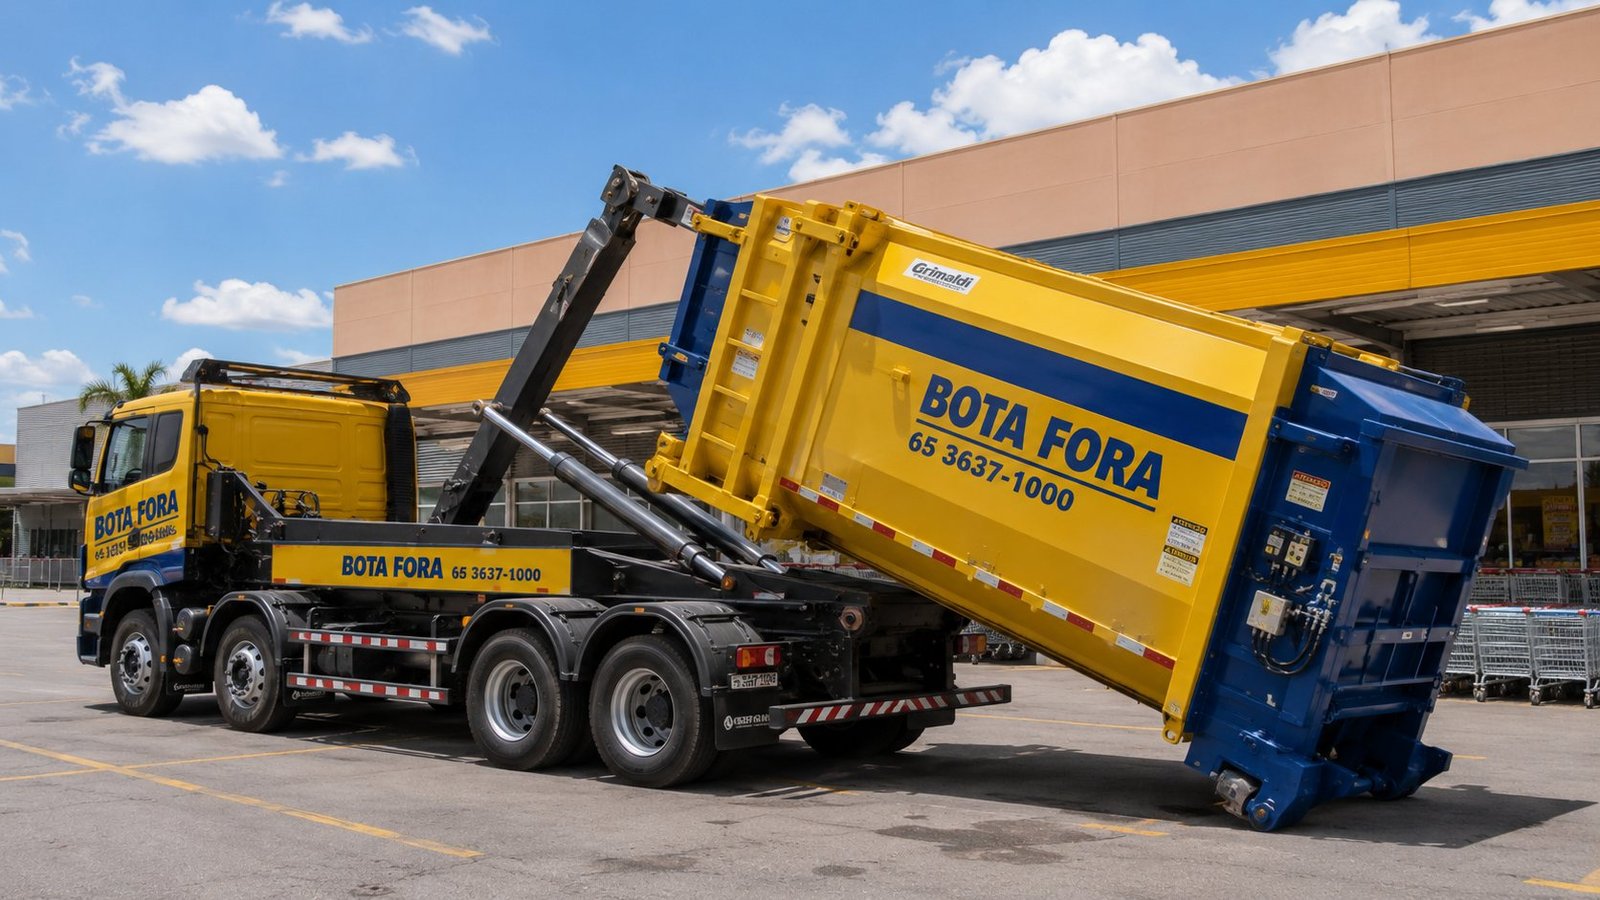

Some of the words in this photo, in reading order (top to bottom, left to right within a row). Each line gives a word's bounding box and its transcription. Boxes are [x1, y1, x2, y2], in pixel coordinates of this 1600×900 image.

[911, 262, 974, 288] Grimaldi
[919, 373, 1028, 450] BOTA
[1037, 416, 1163, 500] FORA
[908, 432, 938, 457] 65
[942, 444, 1075, 511] 3637-1000
[94, 505, 133, 541] BOTA
[137, 489, 179, 525] FORA
[341, 555, 388, 577] BOTA
[393, 556, 444, 579] FORA
[451, 566, 467, 580] 65
[471, 567, 541, 582] 3637-1000
